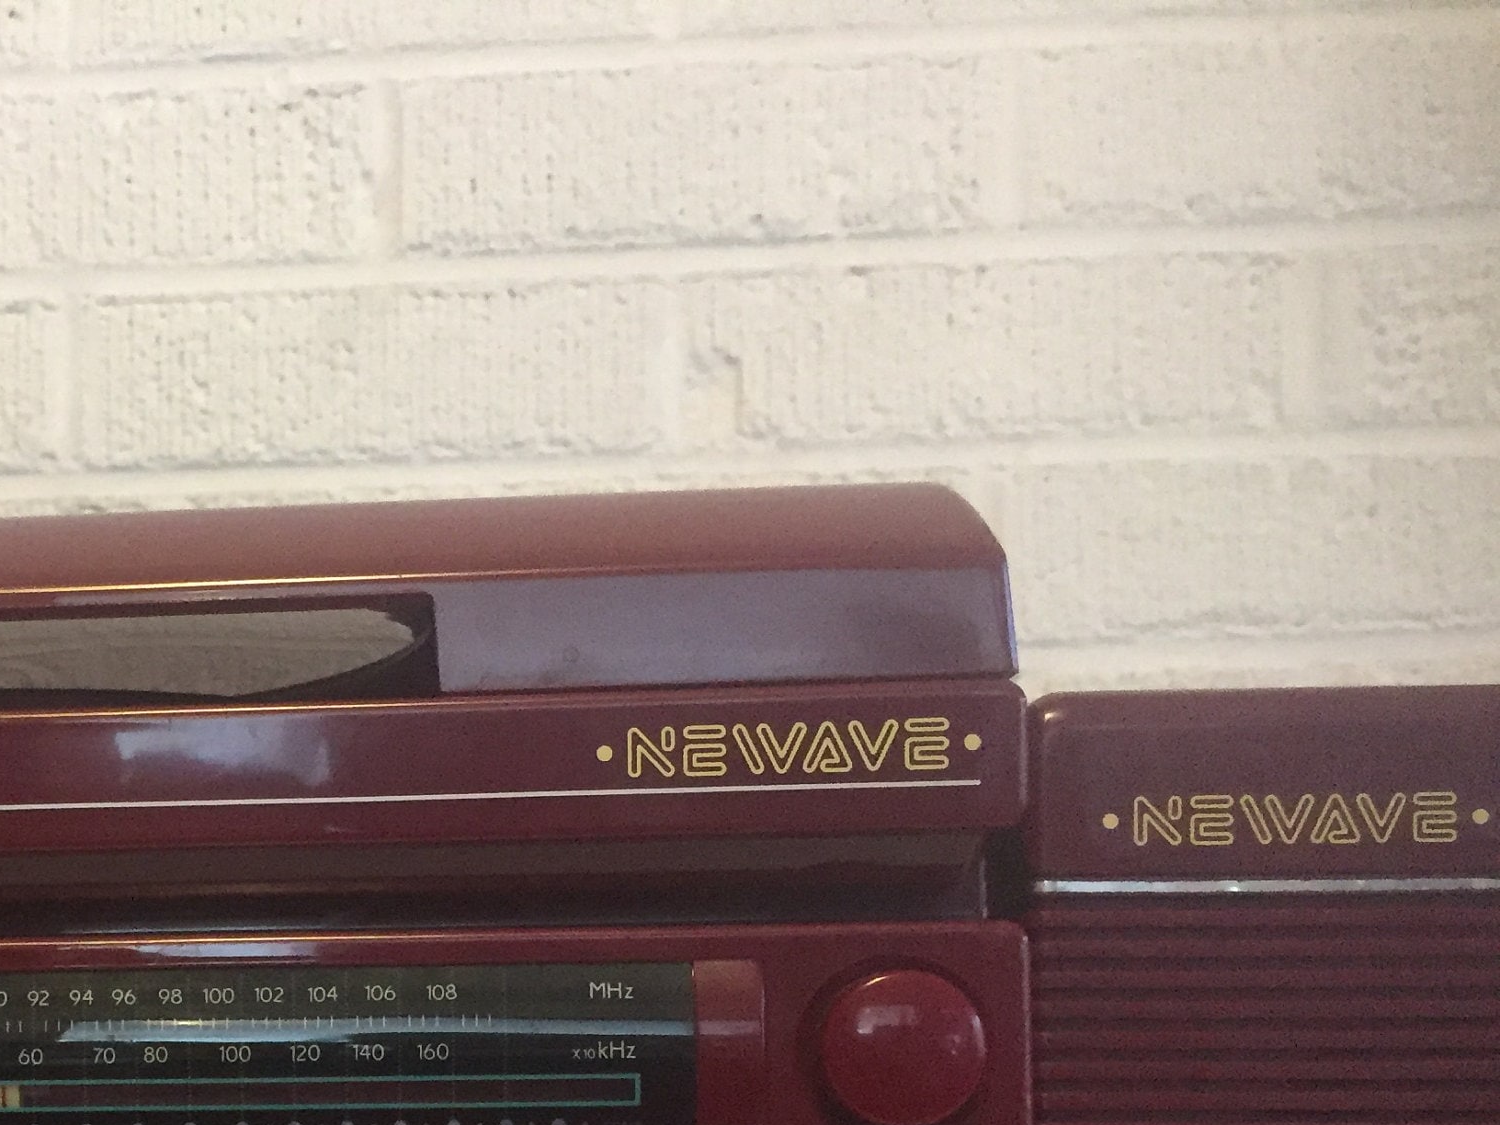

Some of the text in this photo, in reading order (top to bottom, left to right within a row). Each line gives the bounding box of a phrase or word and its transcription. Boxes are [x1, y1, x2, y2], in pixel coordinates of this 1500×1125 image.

[627, 717, 950, 778] NEWAVE
[1133, 792, 1457, 846] NEWAVE
[27, 990, 50, 1007] 92
[69, 989, 94, 1006] 94
[111, 989, 136, 1005] 96
[158, 988, 183, 1005] 98
[203, 987, 235, 1004] 100
[254, 986, 284, 1003] 102
[307, 986, 338, 1002] 104
[364, 985, 396, 1001] 106
[426, 983, 457, 1000] 108
[589, 982, 634, 999] MHz
[17, 1048, 43, 1065] 60
[93, 1047, 116, 1064] 70
[143, 1046, 168, 1063] 80
[219, 1045, 251, 1063] 100
[290, 1045, 321, 1062] 120
[352, 1043, 385, 1061] 140
[417, 1043, 449, 1060] 160
